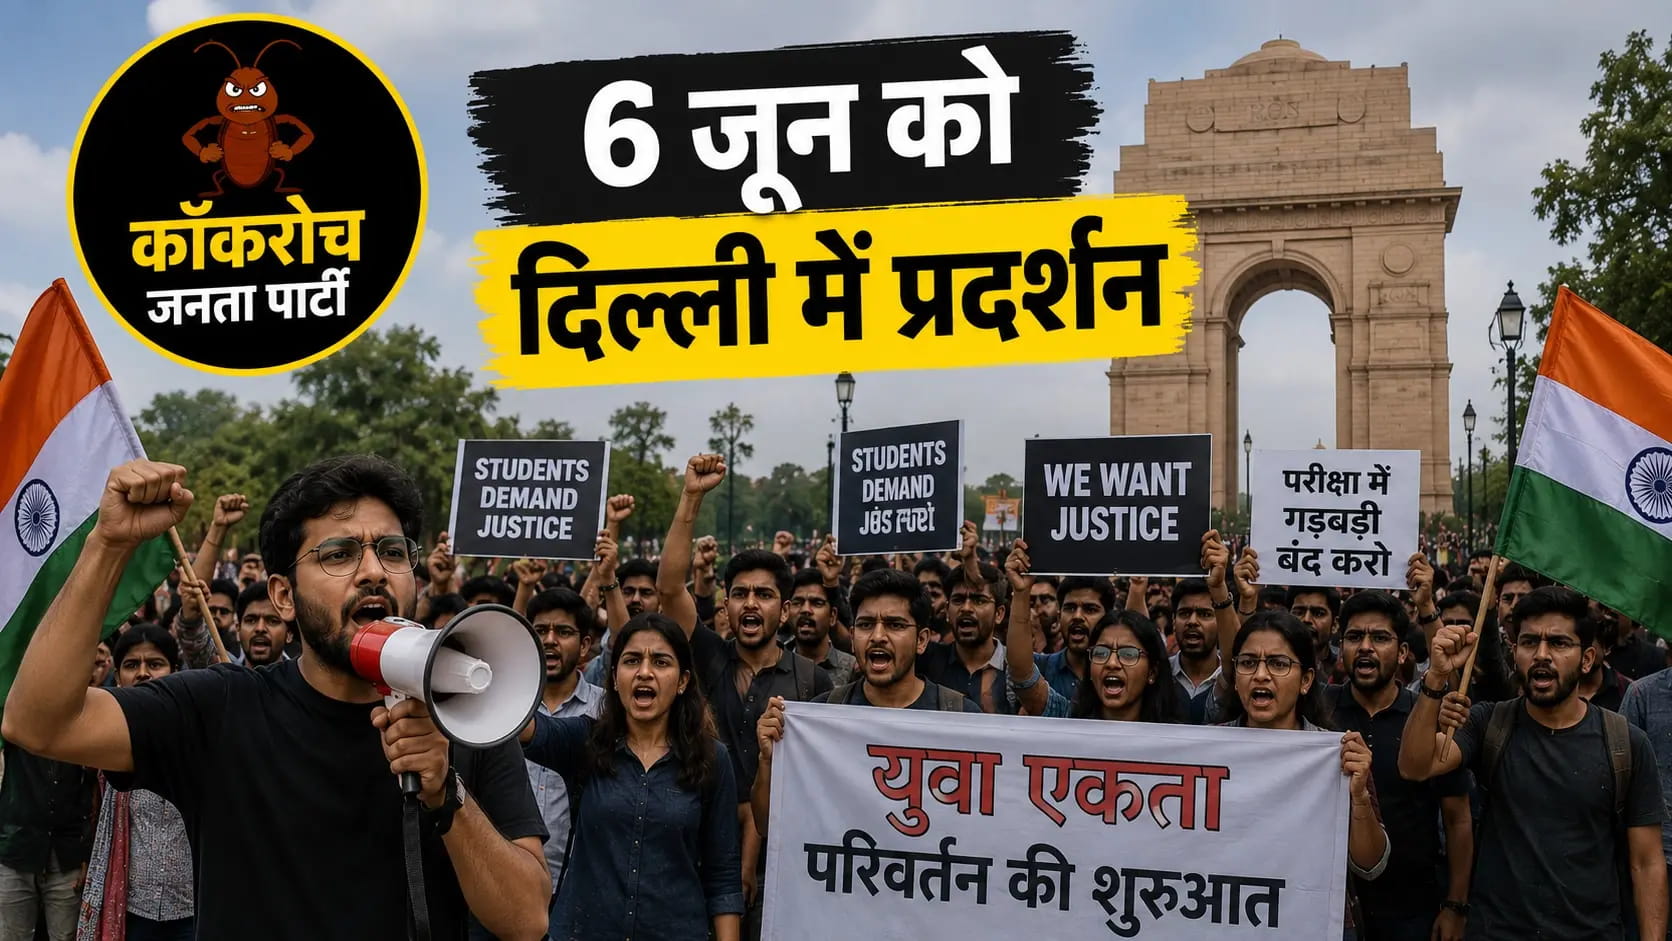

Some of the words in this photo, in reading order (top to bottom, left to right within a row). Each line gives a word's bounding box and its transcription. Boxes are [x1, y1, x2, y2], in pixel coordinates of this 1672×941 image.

[475, 458, 589, 482] STUDENTS
[852, 440, 946, 473] STUDENTS
[862, 474, 935, 503] DEMAND
[1044, 463, 1091, 497] WE
[1100, 462, 1192, 497] WANT
[1282, 463, 1361, 496] परीक्षा
[1367, 464, 1392, 496] में
[480, 486, 578, 510] DEMAND
[477, 515, 573, 540] JUSTICE
[1051, 506, 1179, 541] JUSTICE
[1283, 500, 1383, 540] गड़बड़ी
[1276, 540, 1323, 577] बंद
[1331, 541, 1393, 577] करो
[867, 744, 1002, 836] युवा
[1023, 755, 1231, 832] एकता
[803, 829, 993, 905] परिवर्तन
[1007, 843, 1076, 911] की
[1092, 865, 1286, 938] शुरुआत
